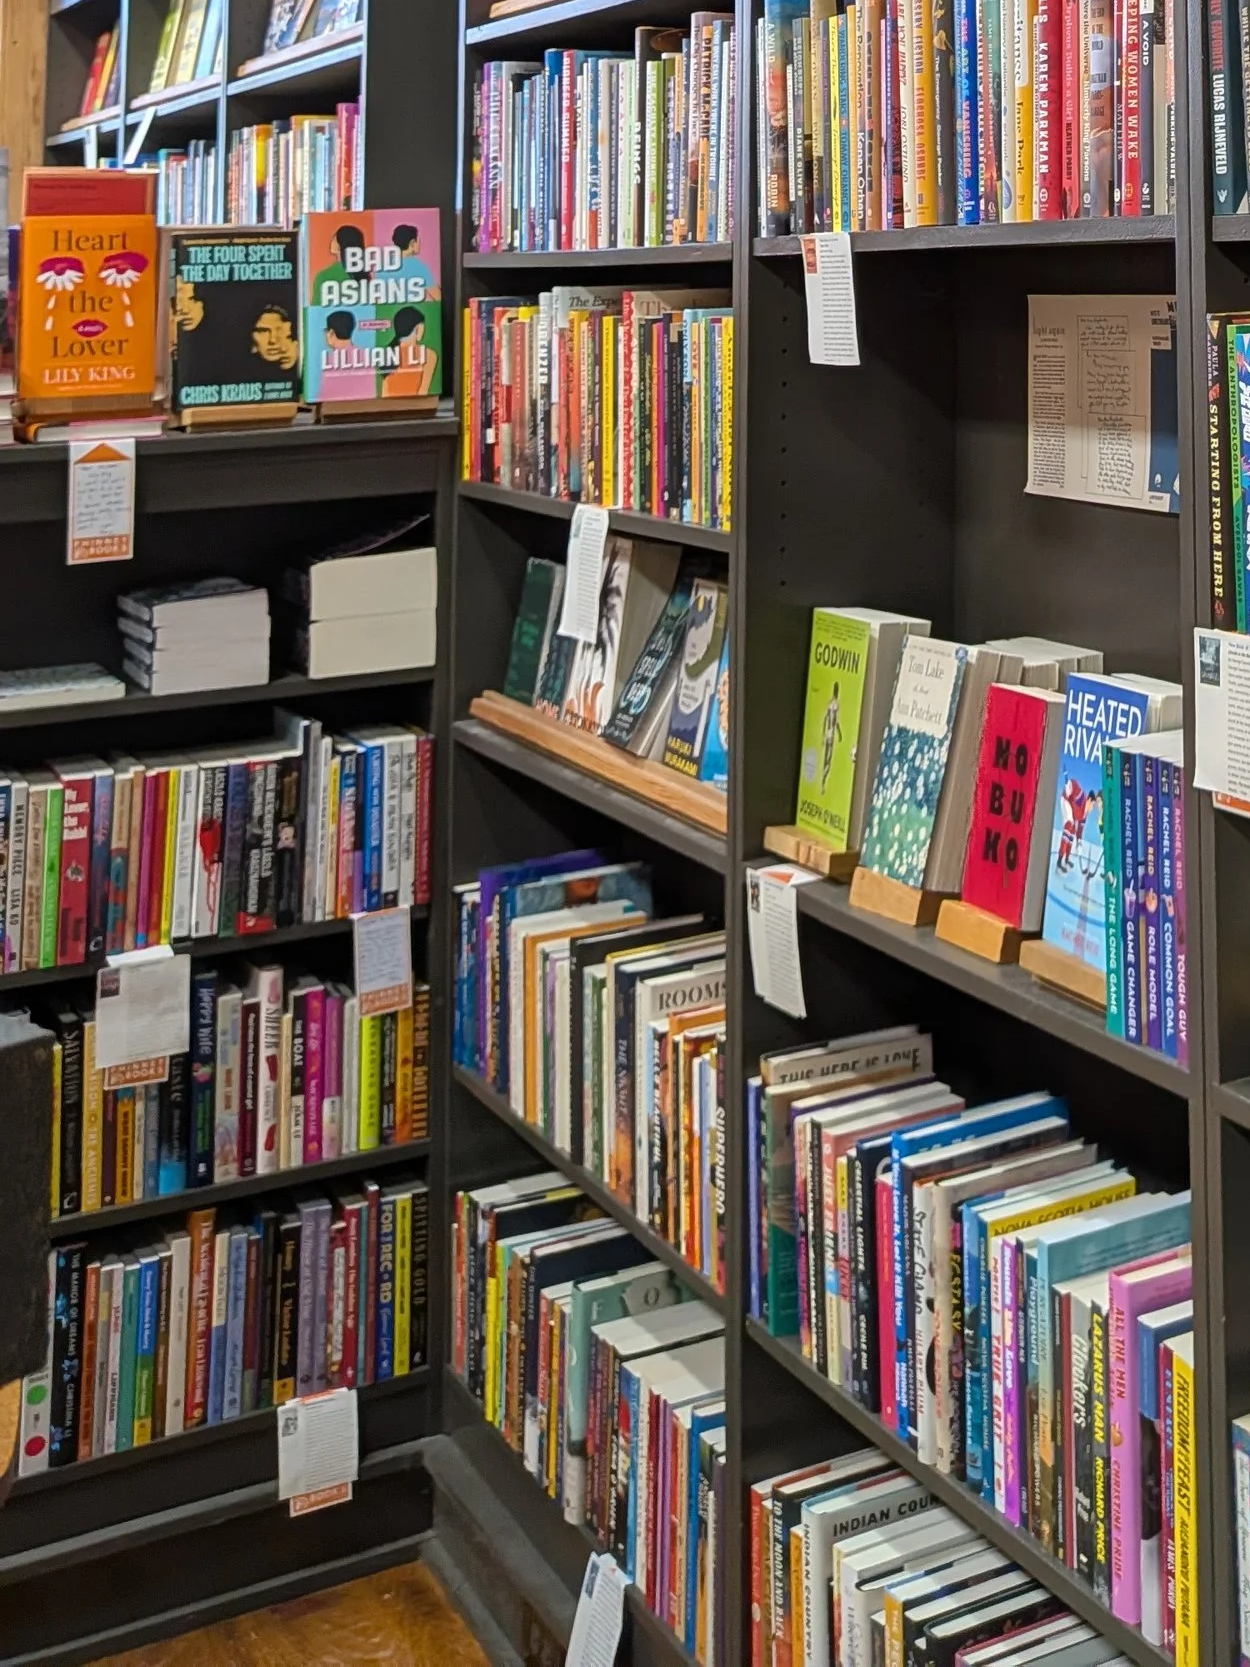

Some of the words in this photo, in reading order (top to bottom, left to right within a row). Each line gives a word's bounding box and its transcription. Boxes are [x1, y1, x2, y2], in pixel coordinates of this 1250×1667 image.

[52, 230, 128, 251] Heart
[189, 247, 212, 263] THE
[214, 247, 246, 263] FOUR
[249, 246, 284, 262] SPENT
[345, 247, 400, 272] BAD
[181, 267, 204, 281] THE
[206, 266, 230, 281] DAY
[233, 264, 292, 281] TOGETHER
[68, 291, 112, 312] the
[322, 279, 426, 307] ASIANS
[51, 335, 129, 359] Lover
[322, 346, 399, 370] LILLIAN
[408, 346, 426, 365] LI
[43, 367, 83, 384] LILY
[88, 366, 135, 381] KING
[181, 385, 219, 402] CHRIS
[221, 384, 262, 401] KRAUS
[814, 643, 859, 674] GODWIN
[1068, 691, 1142, 734] HEATED
[1108, 897, 1116, 924] THE
[1126, 922, 1134, 963] GAME
[1164, 922, 1173, 992] COMMON
[1127, 967, 1136, 1037] CHANGER
[1166, 997, 1174, 1036] GOAL
